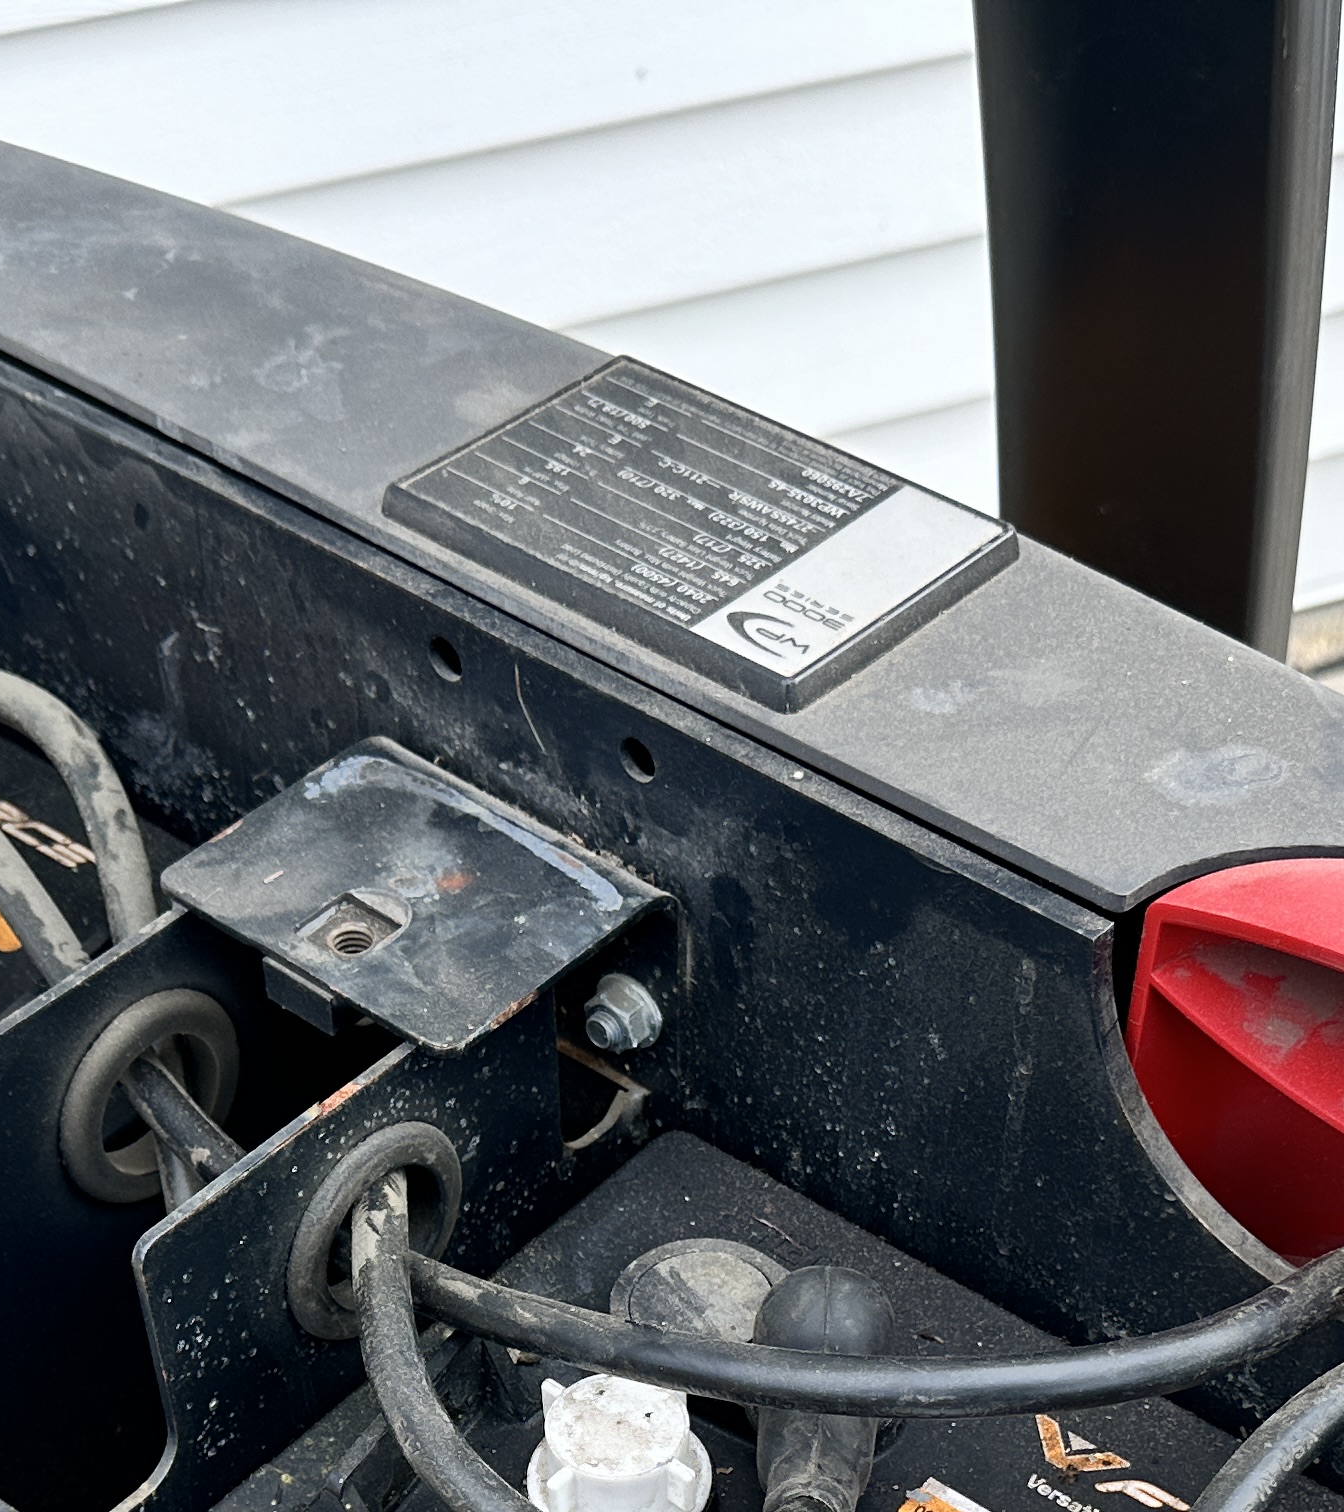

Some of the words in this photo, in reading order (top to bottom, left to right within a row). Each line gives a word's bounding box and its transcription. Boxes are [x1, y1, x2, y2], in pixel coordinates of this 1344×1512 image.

[762, 478, 849, 518] WP3035-45
[795, 467, 871, 502] 7A295060
[688, 531, 734, 555] (717)
[627, 562, 680, 588] (4500)
[672, 583, 715, 605] 2040
[759, 589, 848, 632] 3000
[771, 582, 858, 623] SERIES
